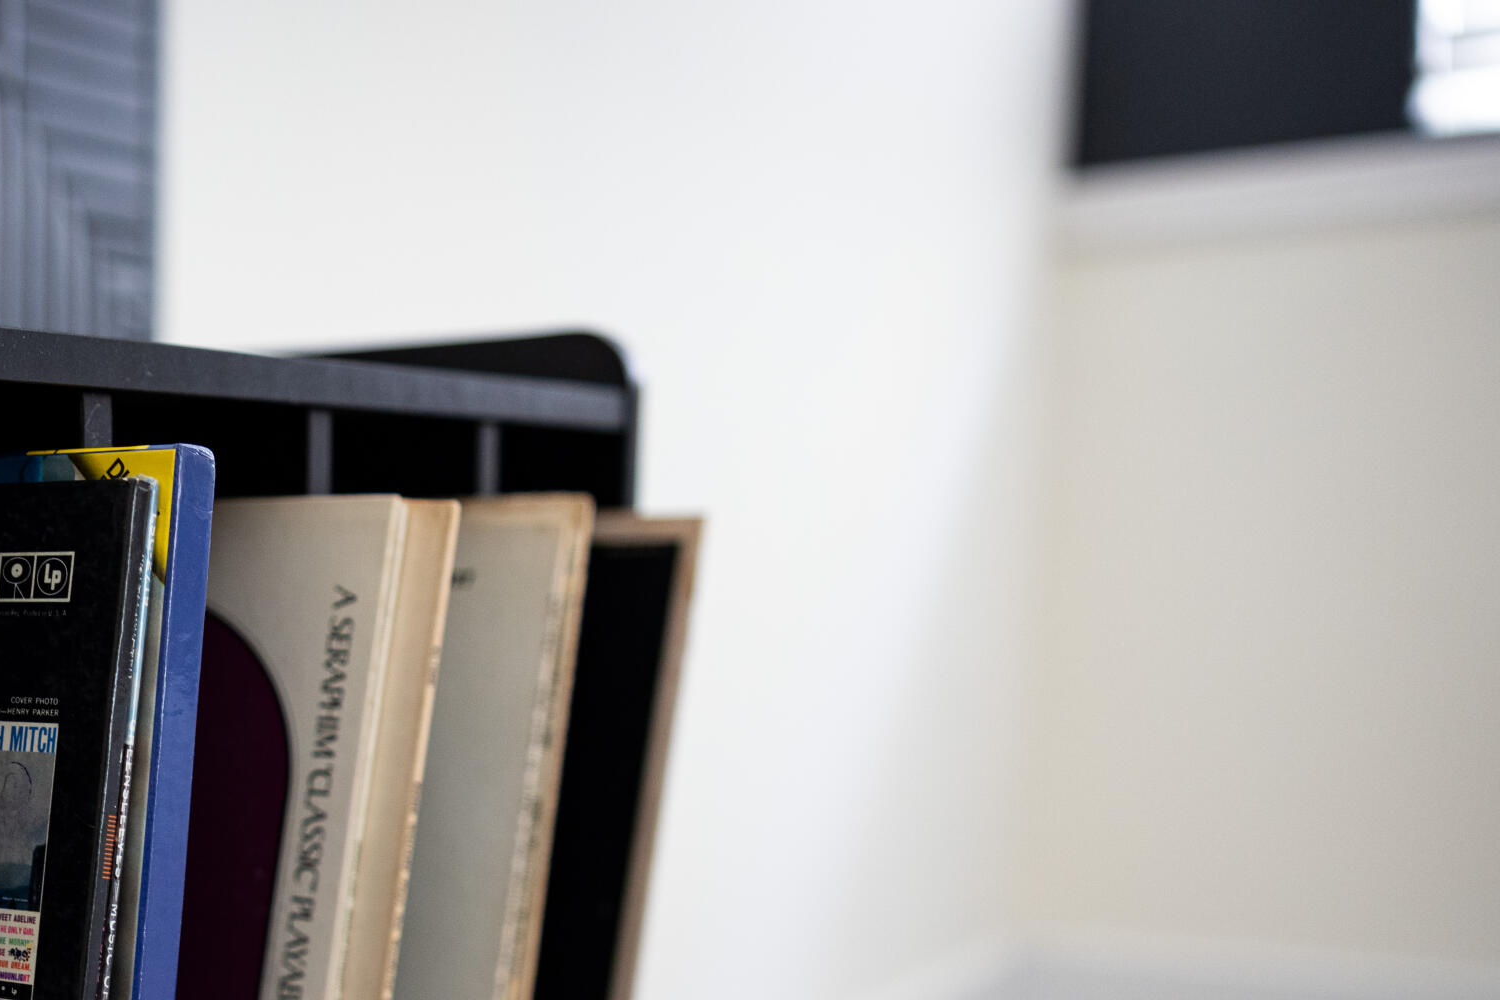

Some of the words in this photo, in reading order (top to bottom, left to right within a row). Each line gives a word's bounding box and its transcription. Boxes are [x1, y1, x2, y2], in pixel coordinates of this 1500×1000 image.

[43, 562, 62, 591] Lp
[332, 585, 358, 608] A
[311, 614, 356, 760] SERAPHIM
[10, 696, 33, 705] COVER
[35, 697, 59, 706] PHOTO
[32, 708, 59, 717] PARKER
[9, 726, 57, 753] MITCH
[13, 914, 36, 923] ADELINE
